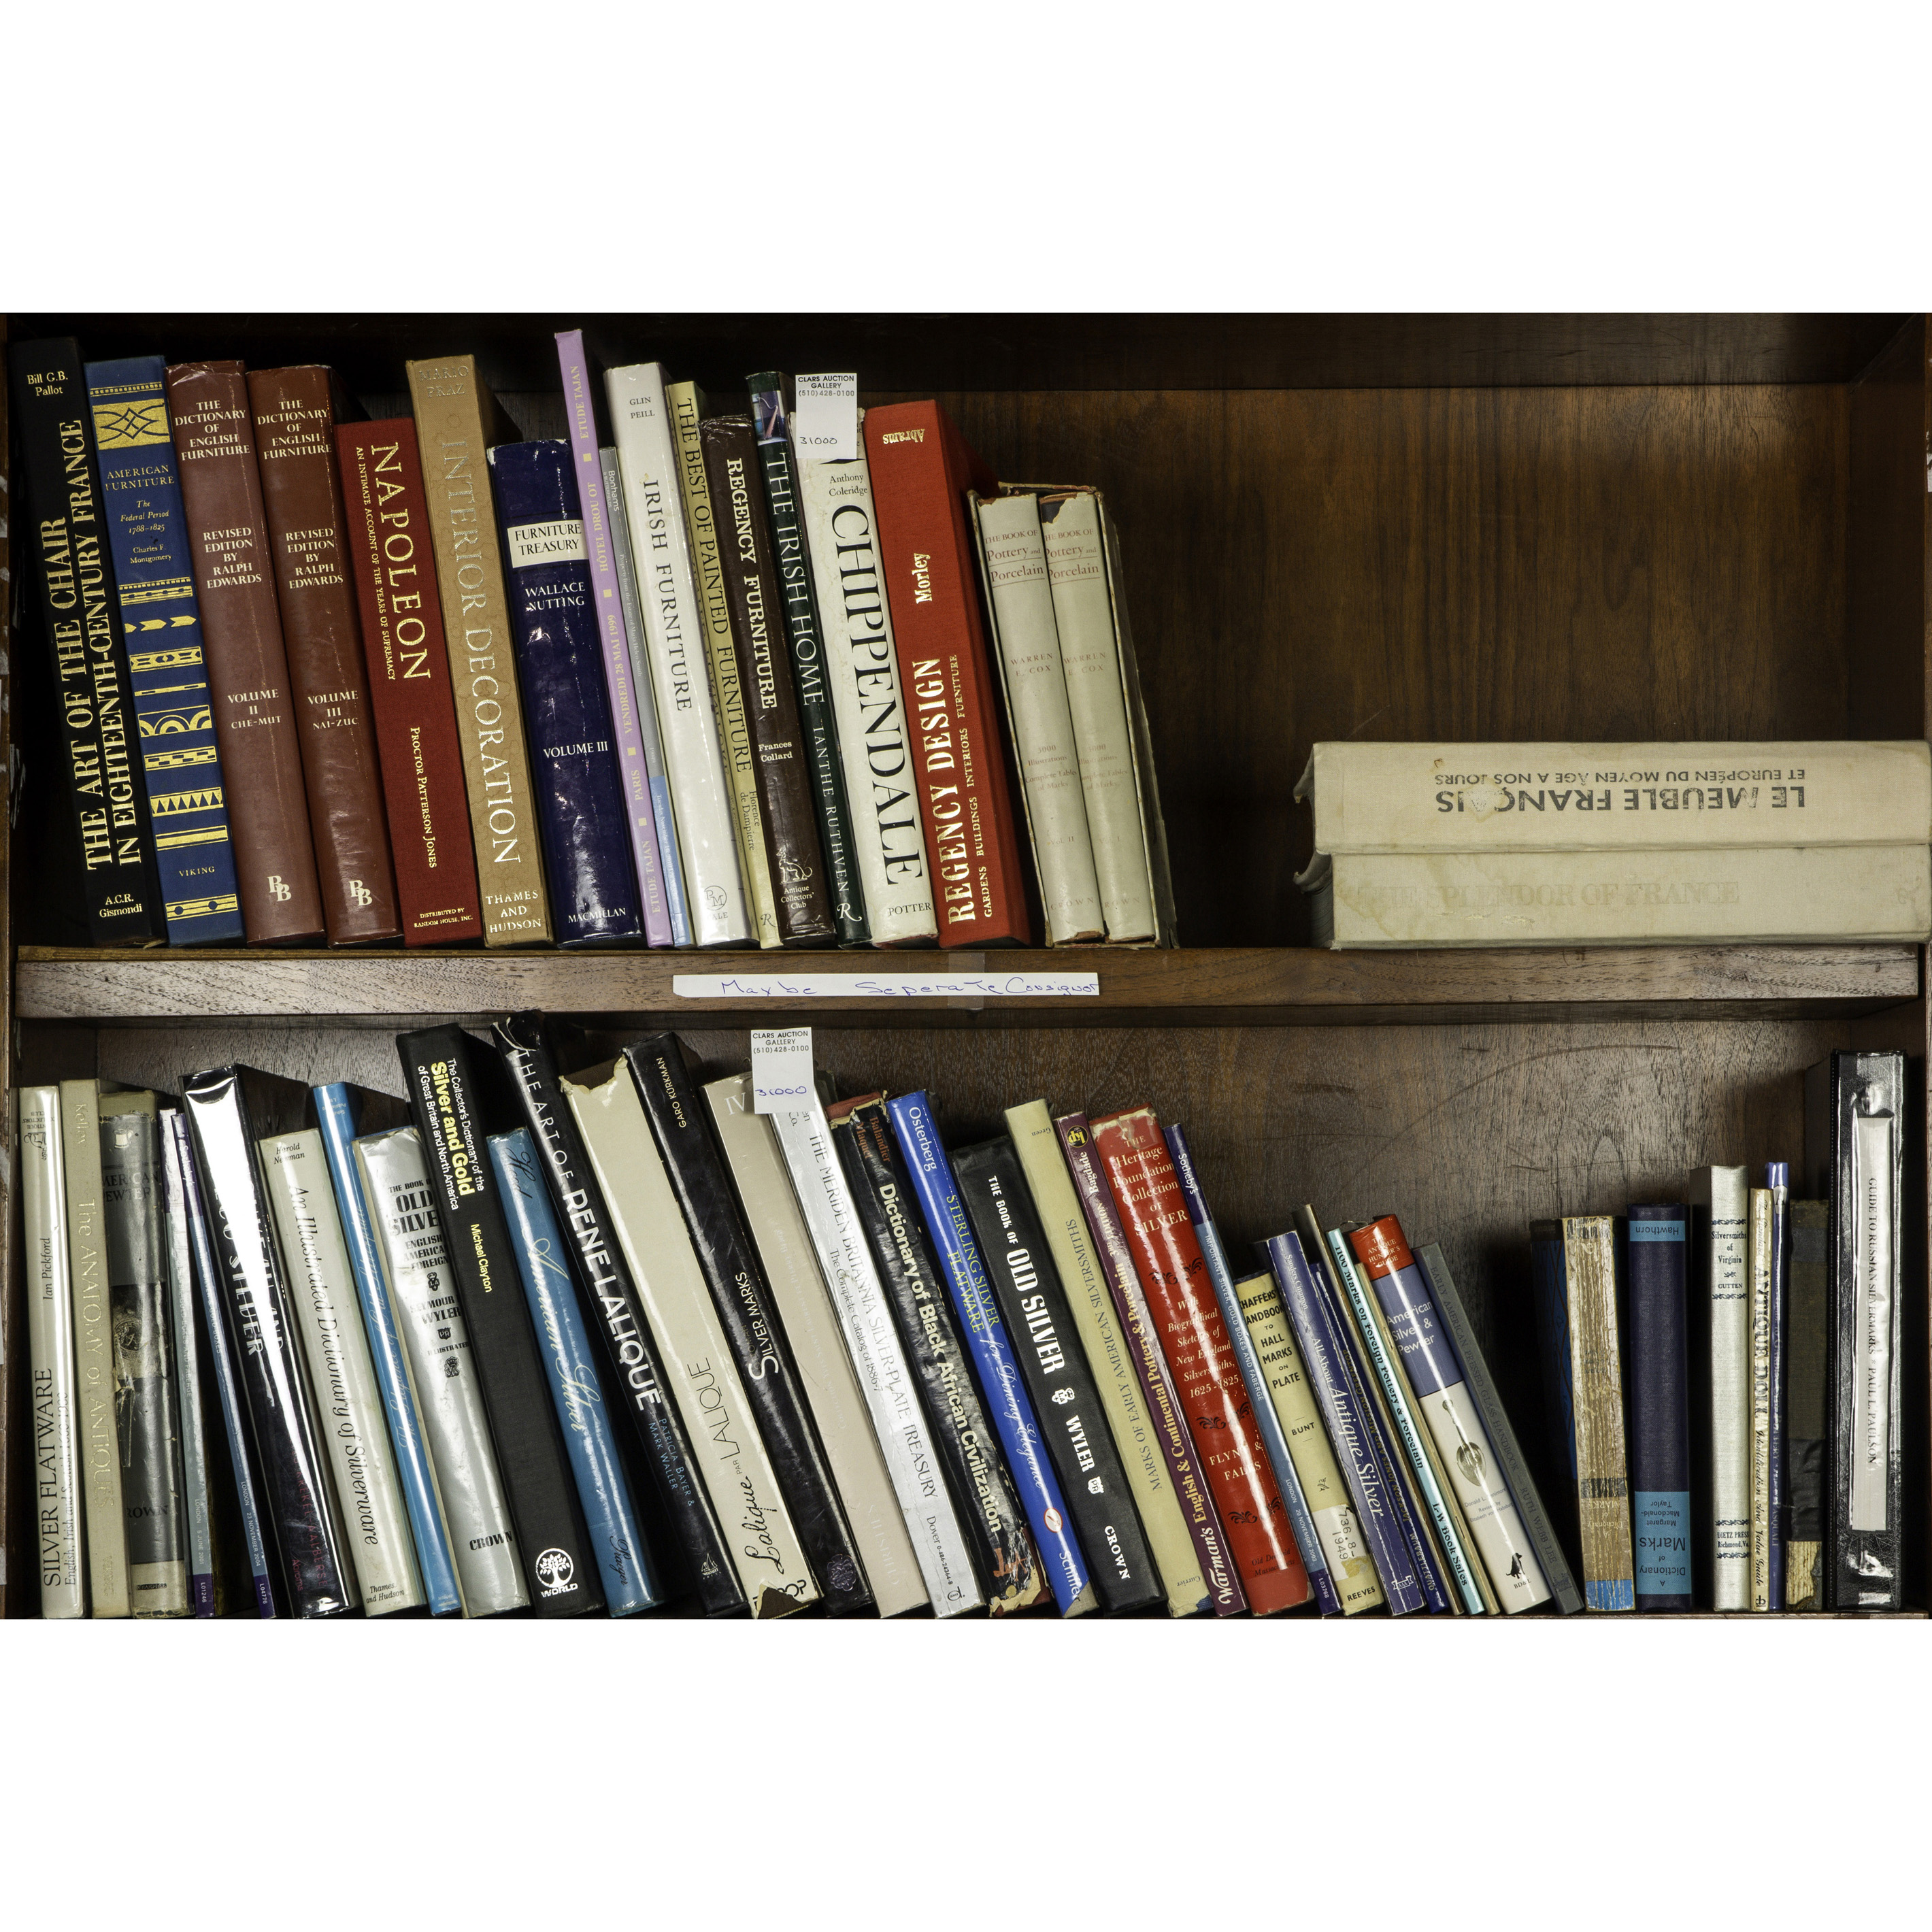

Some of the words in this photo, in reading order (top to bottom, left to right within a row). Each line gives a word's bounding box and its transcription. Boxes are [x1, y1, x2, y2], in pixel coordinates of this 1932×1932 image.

[27, 373, 43, 384] Bill
[47, 371, 68, 382] G.B.
[35, 386, 63, 396] Pallot
[629, 397, 651, 406] GLIN
[175, 410, 246, 426] DICTIONARY
[197, 401, 220, 411] THE
[630, 410, 655, 419] PEILL
[190, 434, 239, 448] ENGLISH
[205, 423, 219, 433] OF
[800, 437, 837, 445] 31000
[181, 445, 250, 461] FURNITURE
[59, 420, 95, 524] FRANCE
[105, 476, 174, 490] FURNITURE
[107, 465, 169, 479] AMERICAN
[766, 452, 795, 514] THE
[830, 474, 864, 484] Anthony
[829, 486, 867, 497] Coleridge
[515, 523, 582, 542] FURNITURE
[518, 539, 579, 556] TREASURY
[986, 547, 1028, 561] Pottery
[40, 517, 77, 609] CHAIR
[371, 442, 431, 680] NAPOLEON
[777, 527, 807, 603] IRISH
[990, 566, 1044, 582] Porcelain
[525, 582, 585, 597] WALLACE
[727, 459, 756, 564] REGENCY
[744, 576, 778, 709] FURNITURE
[912, 553, 932, 604] Morley
[529, 596, 585, 611] NUTTING
[643, 480, 668, 551] IRISH
[656, 563, 692, 712] FURNITURE
[54, 619, 87, 682] THE
[442, 441, 486, 615] INTERIOR
[465, 627, 521, 863] DECORATION
[793, 615, 825, 705] HOME
[76, 533, 136, 829] EIGHTEENTH-CENTURY
[227, 689, 279, 704] VOLUME
[831, 505, 922, 886] CHIPPENDALE
[63, 691, 93, 729] OF
[231, 716, 281, 729] CHE-MUT
[249, 706, 258, 714] II
[912, 659, 956, 773] DESIGN
[544, 743, 594, 759] VOLUME
[597, 742, 607, 752] III
[759, 741, 792, 751] Frances
[761, 751, 793, 762] Collard
[71, 741, 103, 797] ART
[1435, 787, 1612, 812] FRANÇIS
[1625, 788, 1759, 811] MEUBLE
[1771, 785, 1805, 809] LE
[80, 807, 112, 871] THE
[119, 837, 141, 865] IN
[930, 784, 976, 925] REGENCY
[179, 866, 215, 877] VIKING
[486, 890, 538, 904] THAMES
[888, 903, 931, 916] POTTER
[501, 906, 527, 917] AND
[568, 907, 626, 923] MACMILLAN
[490, 918, 542, 933] HUDSON
[721, 981, 818, 994] Maybe
[516, 1049, 541, 1093] THE
[656, 1057, 679, 1099] KÜRKMAN
[533, 1103, 560, 1139] ART
[671, 1100, 686, 1128] GARO
[431, 1061, 451, 1115] Silver
[444, 1117, 460, 1152] and
[452, 1148, 475, 1196] Gold
[908, 1106, 937, 1171] Osterberg
[552, 1150, 574, 1180] OF
[1116, 1146, 1163, 1169] Heritage
[988, 1176, 1001, 1197] THE
[1113, 1163, 1175, 1188] Foundation
[1178, 1153, 1196, 1195] Sotheby's
[288, 1186, 309, 1210] An
[1122, 1181, 1178, 1205] Collection
[1869, 1178, 1878, 1214] GUIDE
[996, 1199, 1013, 1229] BOOK
[1150, 1202, 1162, 1212] OF
[562, 1189, 611, 1273] RENE
[879, 1183, 920, 1278] Dictionary
[1135, 1210, 1188, 1236] SILVER
[1635, 1226, 1679, 1235] Hawthorn
[1711, 1231, 1747, 1239] Silversmiths
[1869, 1217, 1877, 1230] TO
[471, 1224, 486, 1257] Michael
[1007, 1231, 1018, 1244] OF
[1727, 1244, 1733, 1252] of
[41, 1237, 52, 1283] Pickford
[295, 1216, 328, 1313] Illustrated
[947, 1195, 982, 1272] STERLING
[976, 1276, 1000, 1328] SILVER
[1065, 1218, 1103, 1307] SILVERSMITHS
[1718, 1254, 1742, 1265] Virginia
[1868, 1233, 1877, 1280] RUSSIAN
[478, 1256, 492, 1292] Clayton
[1006, 1249, 1038, 1291] OLD
[43, 1286, 52, 1300] Ian
[735, 1272, 760, 1313] MARKS
[912, 1278, 930, 1301] of
[947, 1252, 984, 1333] FLATWARE
[1114, 1263, 1141, 1322] Porcelain
[918, 1305, 944, 1357] Black
[1021, 1295, 1065, 1375] SILVER
[1132, 1321, 1146, 1335] &
[1261, 1334, 1284, 1348] HALL
[595, 1275, 661, 1411] LALIQUE
[748, 1314, 779, 1380] SILVER
[1095, 1308, 1127, 1379] AMERICAN
[1262, 1347, 1293, 1364] MARKS
[316, 1317, 350, 1416] Dictionary
[1137, 1334, 1163, 1391] Pottery
[1273, 1372, 1300, 1388] PLATE
[937, 1362, 968, 1429] African
[1120, 1382, 1140, 1422] EARLY
[687, 1358, 741, 1461] LALIQUE
[1154, 1385, 1184, 1459] Continental
[35, 1367, 58, 1500] FLATWARE
[337, 1422, 361, 1437] of
[1134, 1424, 1146, 1444] OF
[1291, 1422, 1315, 1435] BUNT
[1313, 1338, 1321, 1354] All
[1319, 1356, 1333, 1383] About
[1330, 1387, 1363, 1457] Antique
[1357, 1463, 1383, 1517] Silver
[1065, 1415, 1095, 1472] WYLER
[1139, 1448, 1162, 1491] MARKS
[1177, 1459, 1190, 1472] &
[961, 1430, 1001, 1533] Civilization
[346, 1445, 378, 1546] Silverware
[1182, 1474, 1208, 1523] English
[44, 1505, 60, 1586] SILVER
[469, 1531, 513, 1551] CROWN
[1105, 1525, 1131, 1579] CROWN
[1639, 1537, 1686, 1550] Marks
[1201, 1527, 1233, 1605] Warman's
[1639, 1566, 1686, 1576] Dictionary
[542, 1582, 578, 1597] WORLD
[1348, 1586, 1376, 1601] REEVES
